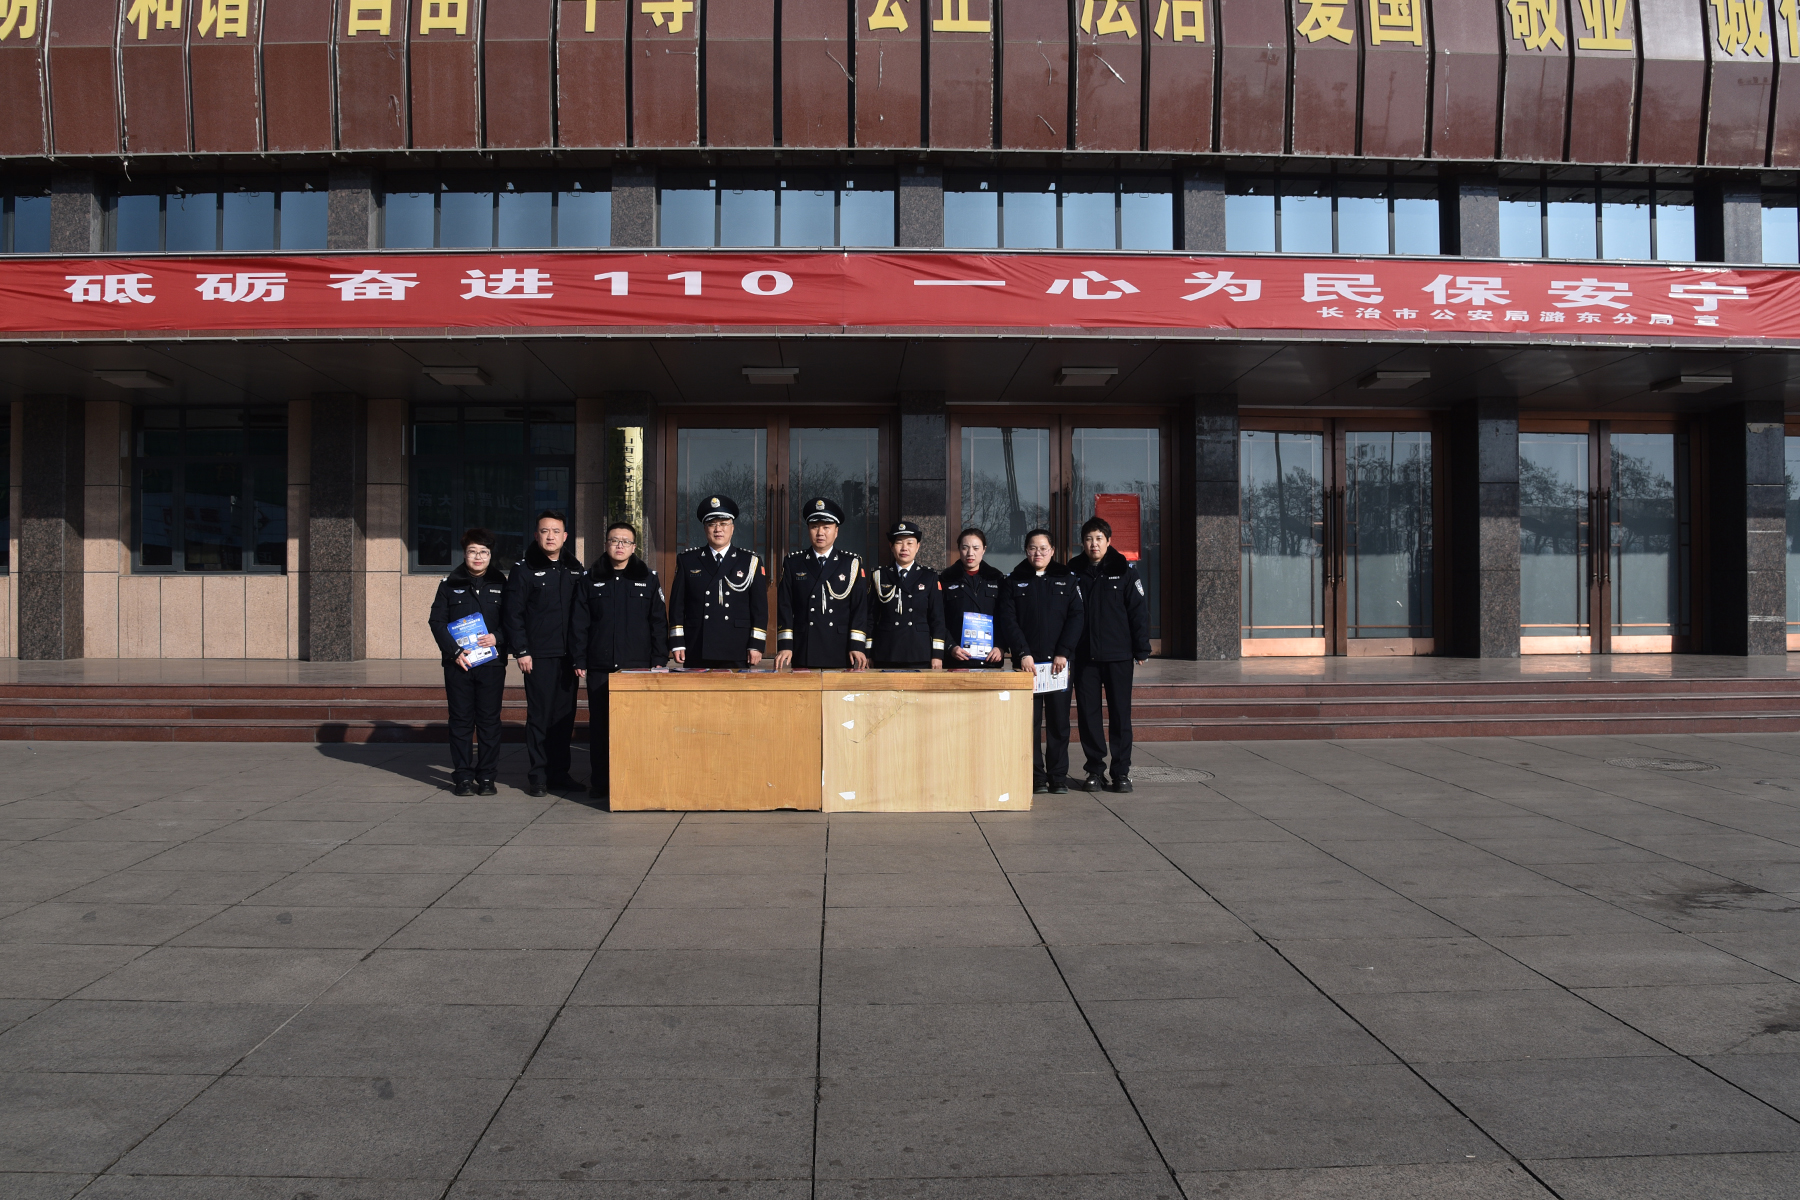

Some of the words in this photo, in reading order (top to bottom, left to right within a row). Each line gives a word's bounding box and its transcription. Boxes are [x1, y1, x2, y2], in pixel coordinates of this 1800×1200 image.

[1296, 0, 1423, 46] 爱国
[1506, 0, 1633, 50] 敬业
[64, 268, 794, 304] 砥砺奋进110
